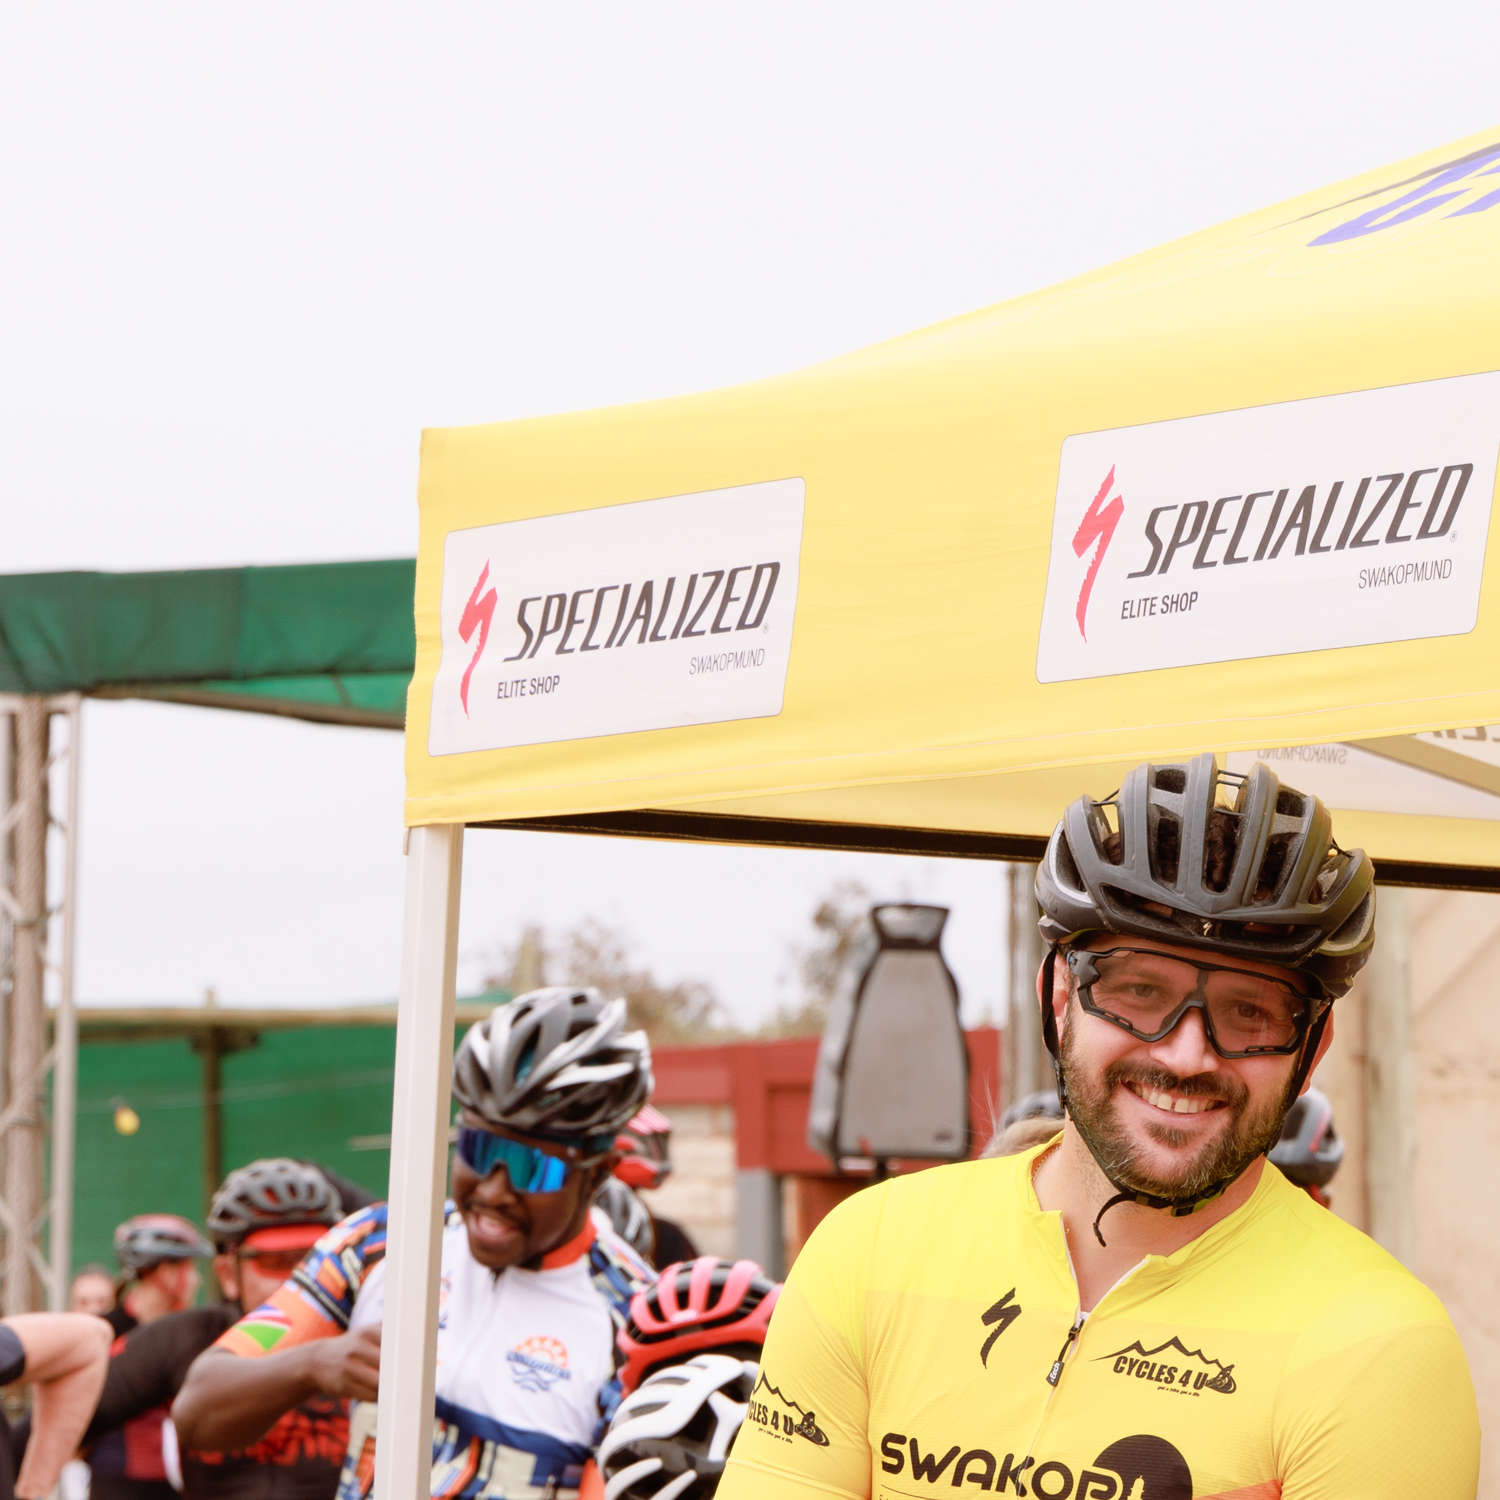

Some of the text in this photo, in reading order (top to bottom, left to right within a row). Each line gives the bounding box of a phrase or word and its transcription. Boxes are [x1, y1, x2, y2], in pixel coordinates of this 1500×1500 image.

[1126, 463, 1474, 579] SPECIALIZED
[1358, 558, 1453, 590] SWAKOPMUND
[502, 561, 781, 663] SPECIALIZED
[1121, 591, 1199, 620] ELITE SHOP
[689, 647, 766, 676] SWAKOPMUND
[496, 674, 560, 700] ELITE SHOP
[1113, 1356, 1208, 1390] CYCLES 4 U
[771, 1410, 780, 1431] 4
[783, 1414, 794, 1436] U
